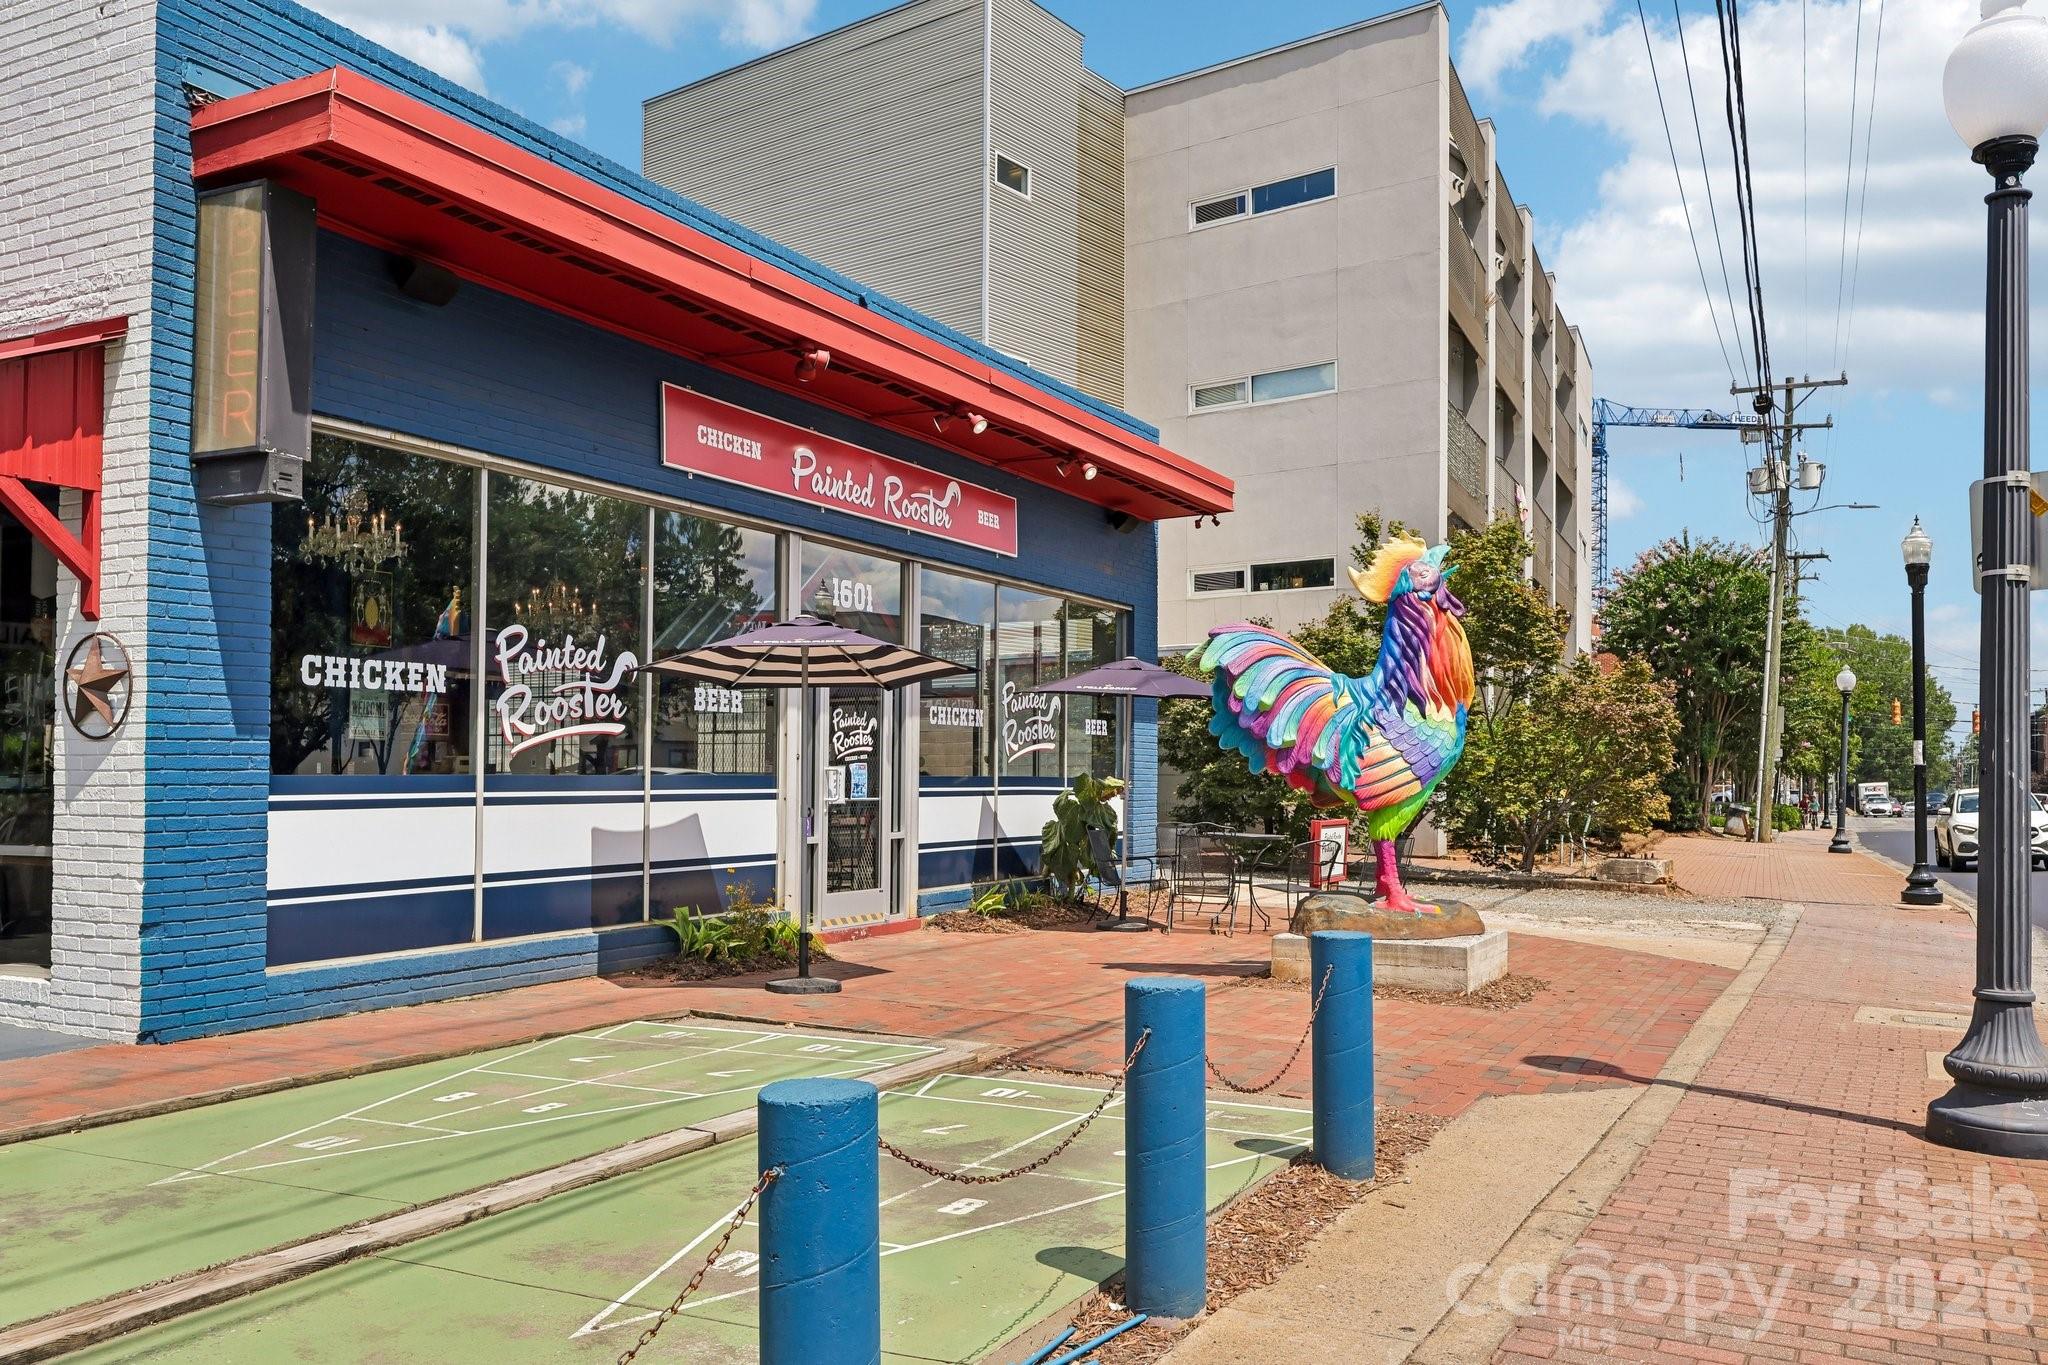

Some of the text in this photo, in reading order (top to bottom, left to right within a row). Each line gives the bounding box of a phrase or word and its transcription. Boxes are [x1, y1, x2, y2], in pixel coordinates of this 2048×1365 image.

[223, 213, 257, 438] BEER
[697, 424, 762, 461] CHICKEN
[791, 446, 961, 529] Painted Rooster
[977, 509, 1000, 530] BEER
[832, 577, 873, 612] 1601
[494, 624, 608, 685] Painted
[300, 654, 447, 694] CHICKEN
[495, 651, 639, 745] Rooster
[694, 687, 744, 714] BEER
[929, 706, 984, 728] CHICKEN
[1002, 680, 1048, 718] Painted
[832, 707, 868, 731] Painted
[832, 717, 878, 756] Rooster
[1002, 695, 1061, 757] Rooster
[1084, 719, 1109, 736] BEER
